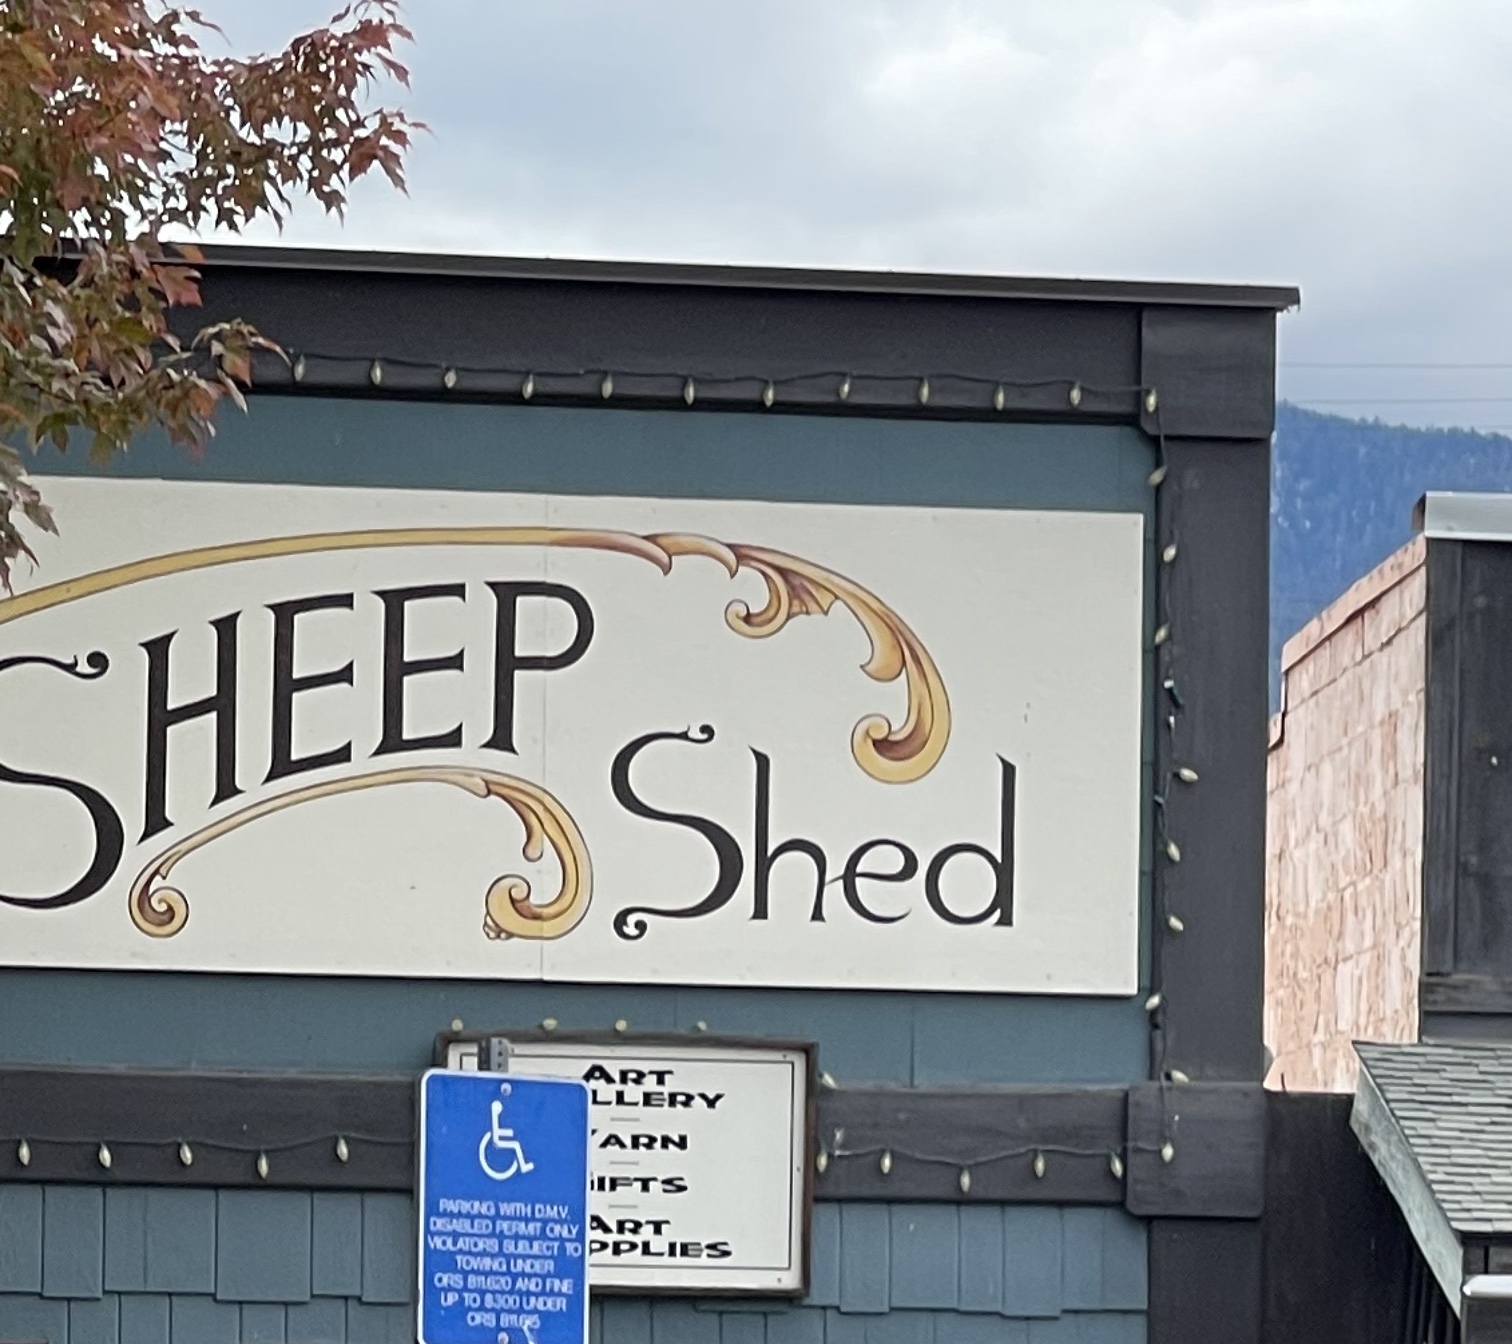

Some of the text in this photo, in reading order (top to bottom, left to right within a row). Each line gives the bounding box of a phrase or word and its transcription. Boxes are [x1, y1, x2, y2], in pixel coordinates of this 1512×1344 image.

[0, 581, 595, 910] SHEEP
[611, 723, 1017, 941] Shed
[582, 1063, 674, 1087] ART
[591, 1089, 725, 1110] LLERY
[591, 1129, 688, 1151] ARN
[590, 1173, 689, 1194] IFTS
[439, 1198, 496, 1217] PARKING
[499, 1202, 532, 1218] WITH
[429, 1216, 579, 1239] DISABLED PERMIT ONLY
[427, 1234, 582, 1258] VIOLATORS SUBJECT TO
[589, 1239, 733, 1259] PPLIES
[455, 1254, 555, 1275] TOWING UNDER
[434, 1272, 463, 1290] ORS
[515, 1276, 543, 1293] AND
[546, 1278, 574, 1295] FINE
[440, 1291, 459, 1307] UP
[463, 1292, 480, 1308] TO
[522, 1295, 567, 1312] UNDER
[466, 1311, 496, 1328] ORS
